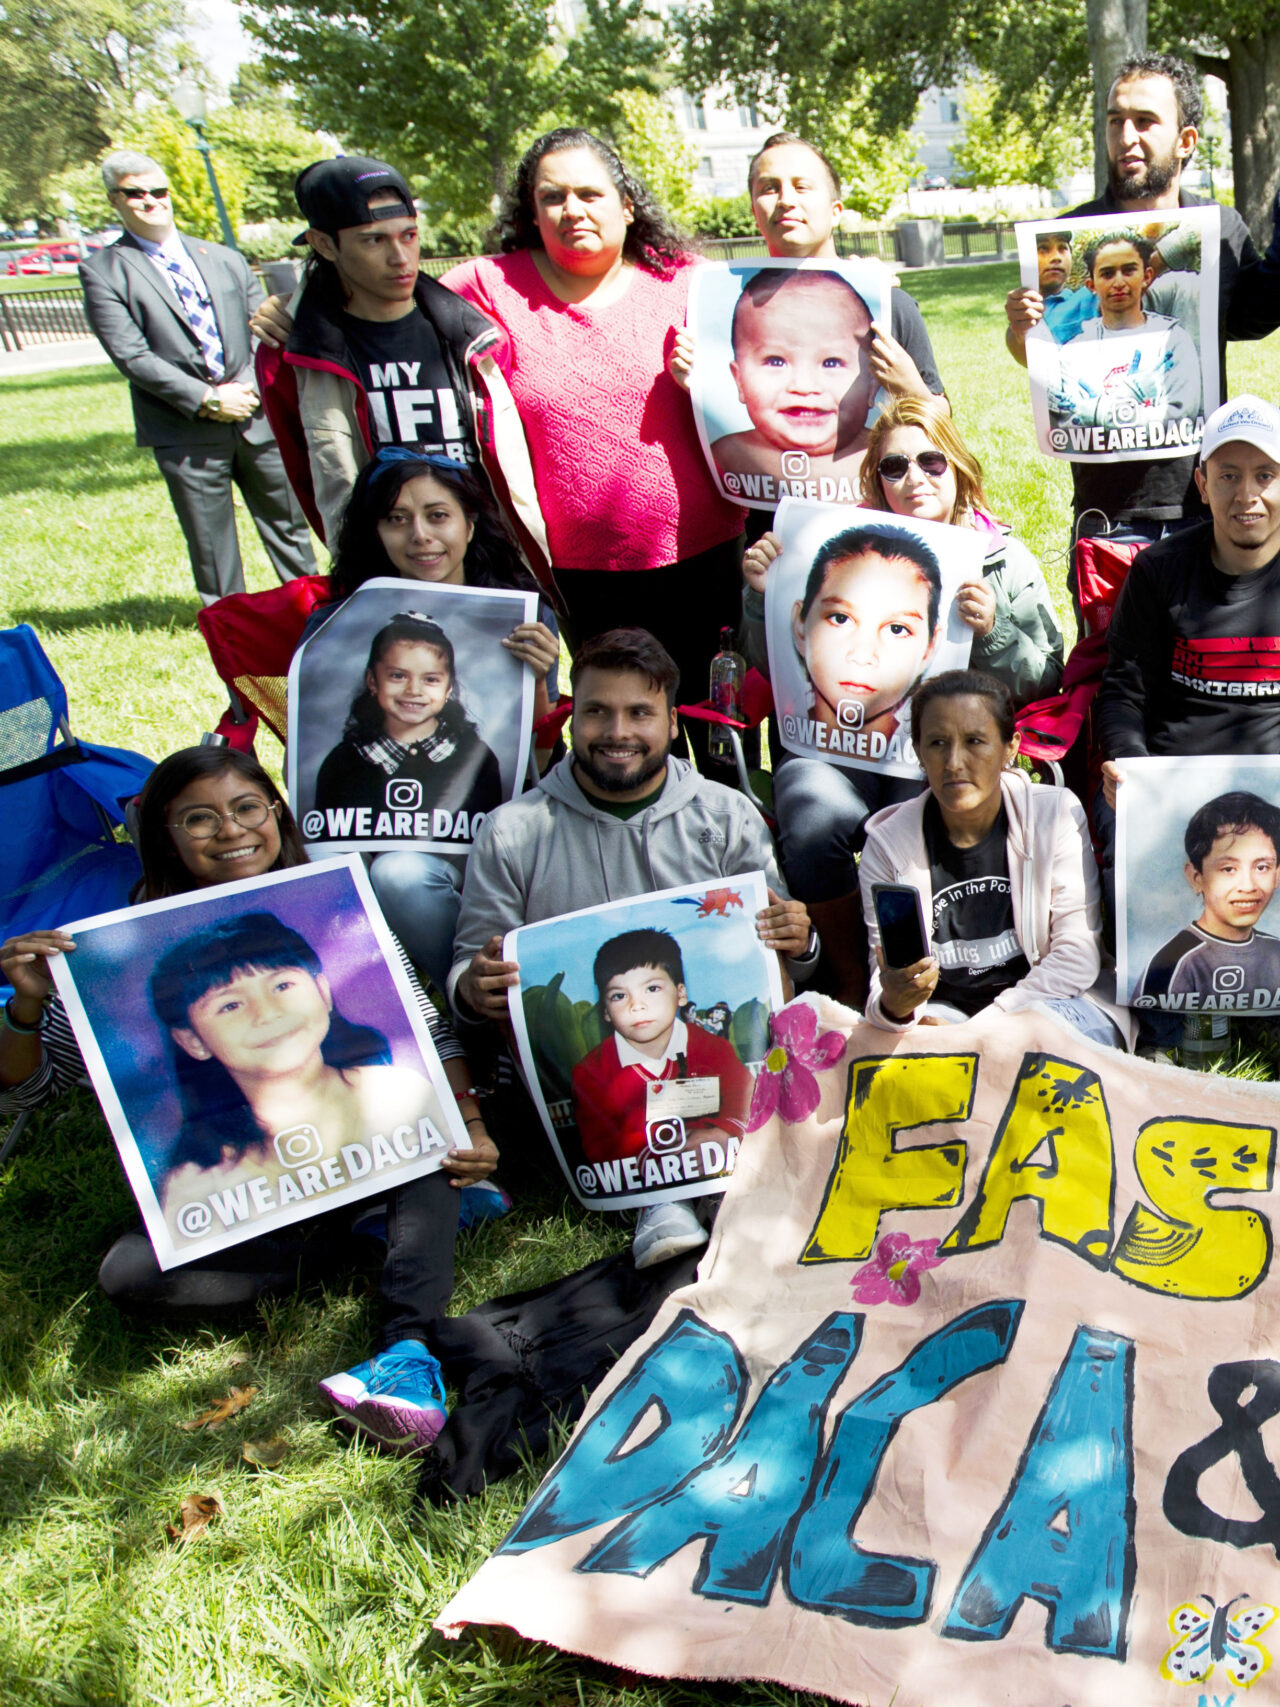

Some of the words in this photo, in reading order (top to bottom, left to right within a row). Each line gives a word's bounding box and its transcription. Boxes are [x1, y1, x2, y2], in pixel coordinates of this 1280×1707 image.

[369, 361, 422, 388] MY
[948, 891, 963, 902] in
[966, 882, 986, 895] the
[990, 879, 1011, 894] Pos
[989, 933, 1018, 960] uni
[176, 1115, 448, 1239] @WEAREDACA
[496, 1299, 1137, 1664] DACA
